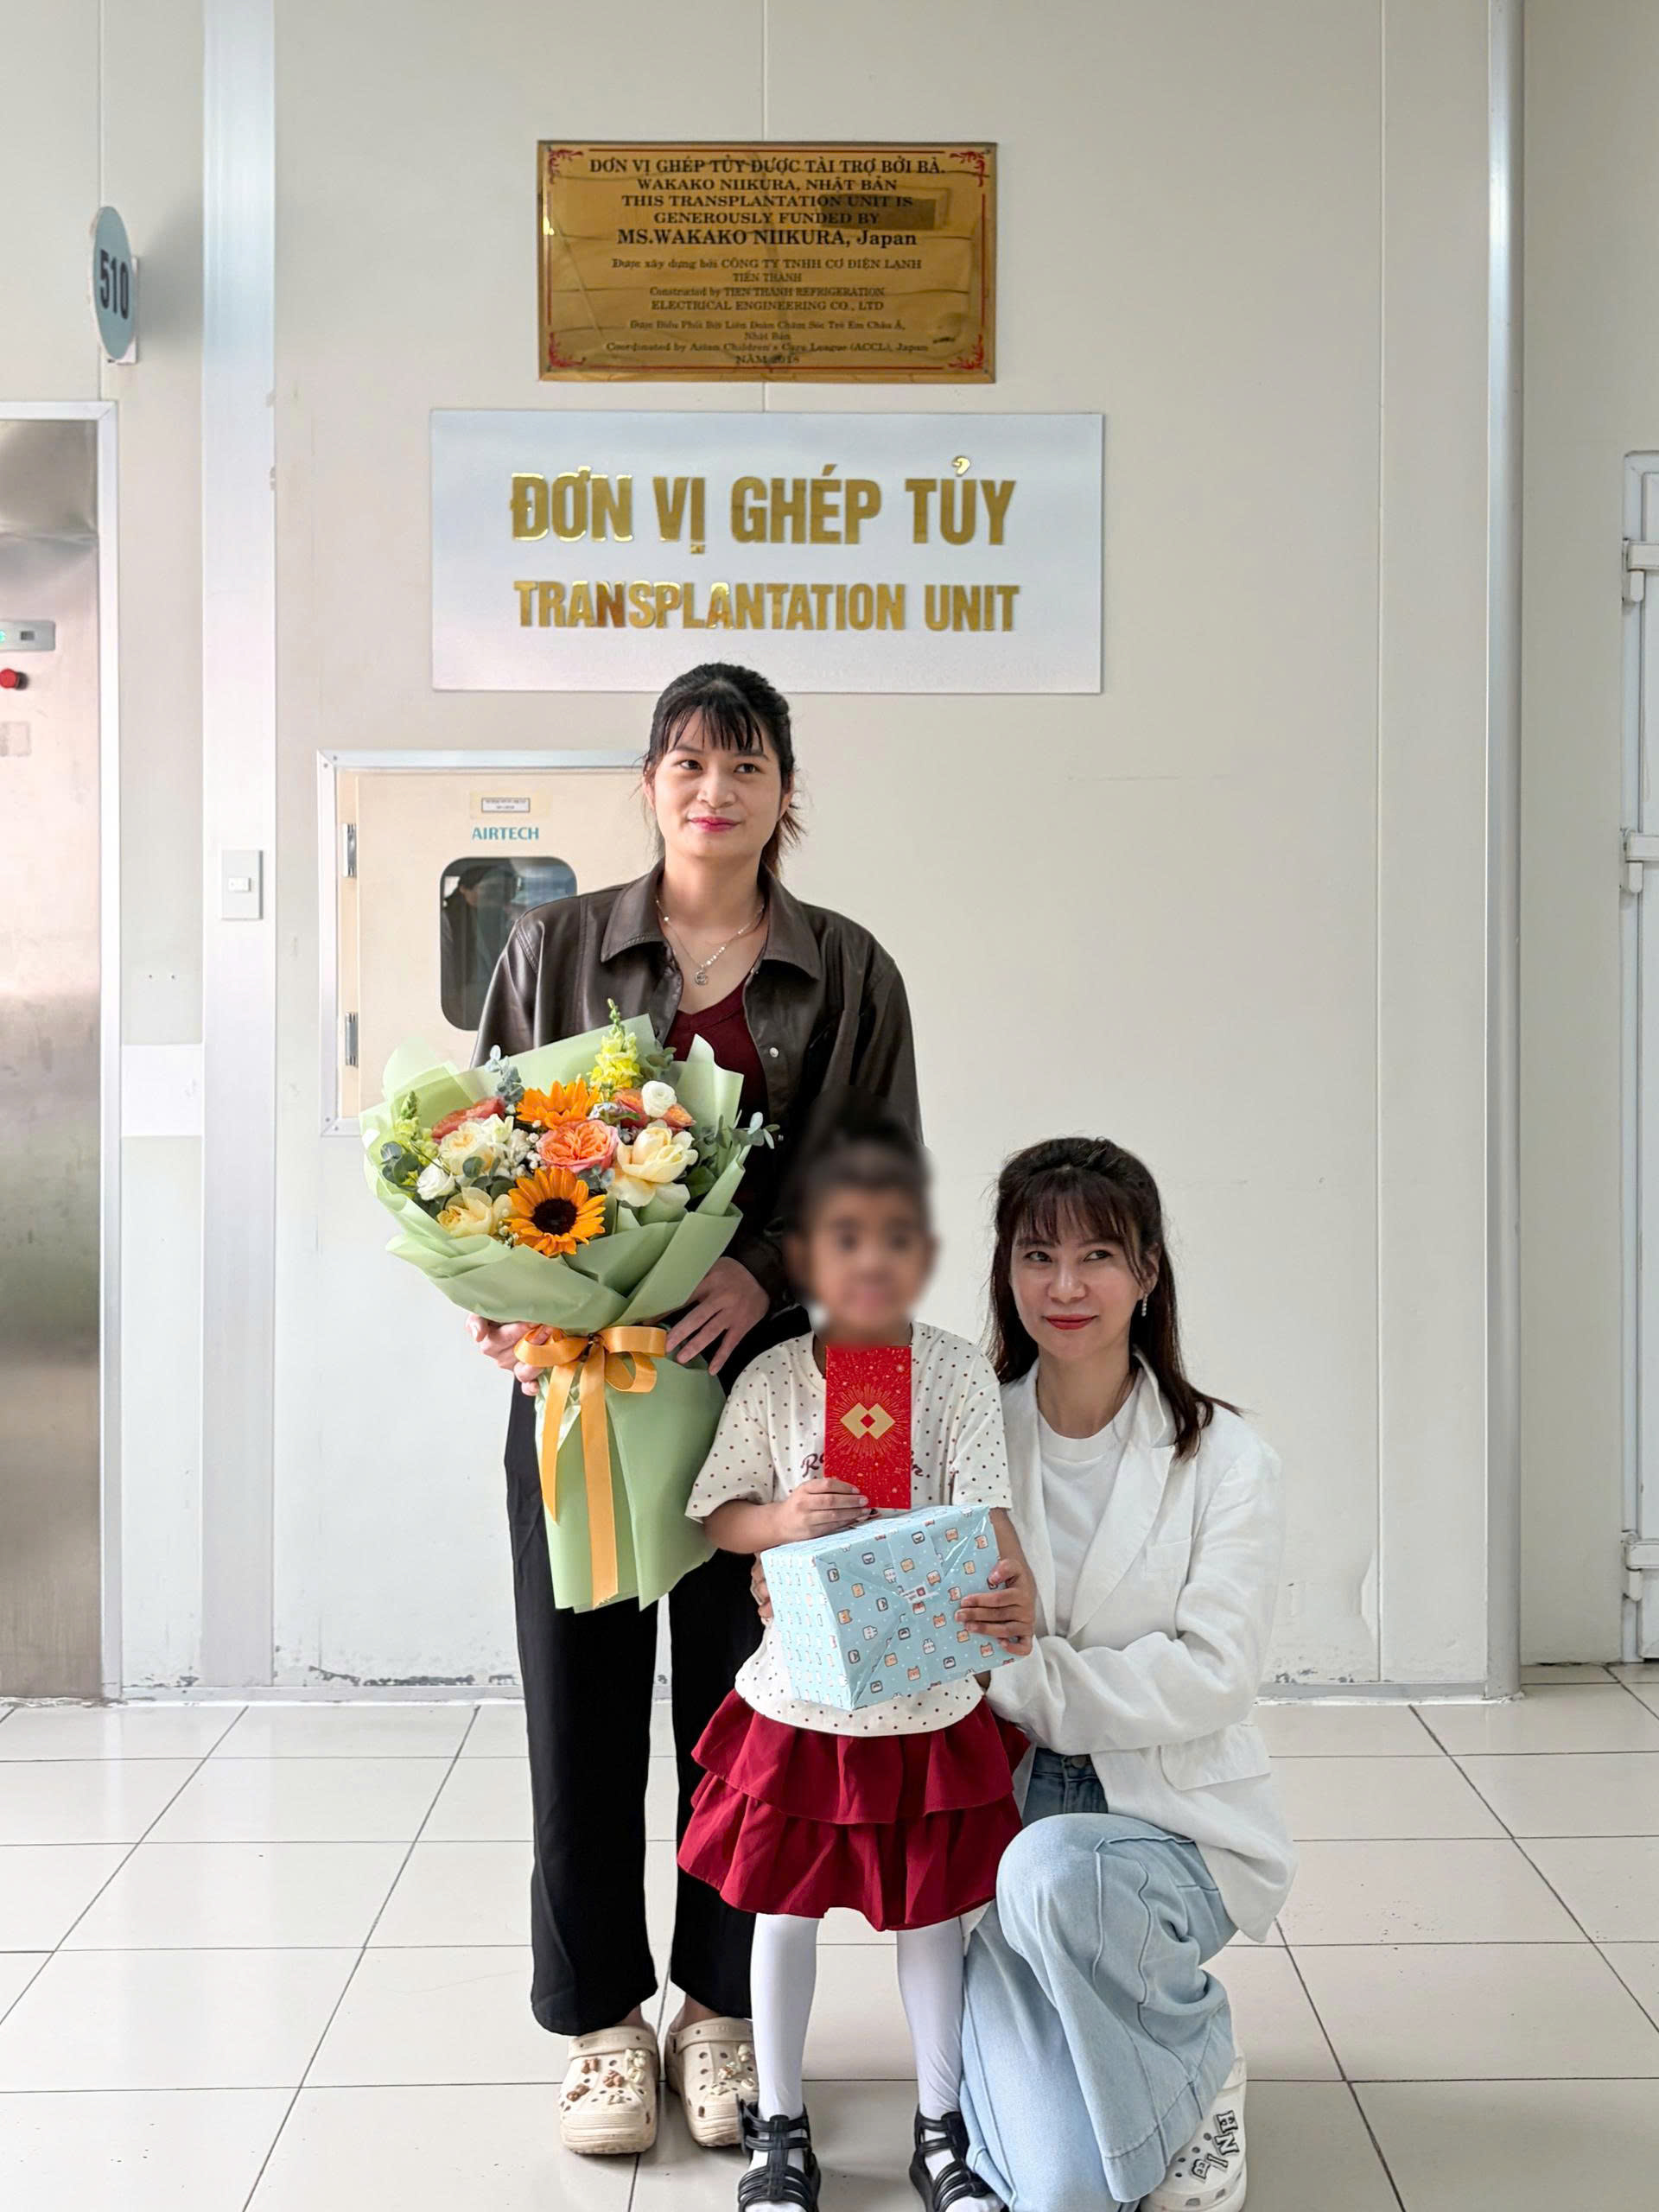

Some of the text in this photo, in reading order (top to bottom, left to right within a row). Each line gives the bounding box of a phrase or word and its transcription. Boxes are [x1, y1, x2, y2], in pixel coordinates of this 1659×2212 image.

[590, 156, 627, 173] ĐƠN
[632, 159, 650, 176] VỊ
[656, 156, 704, 173] GHÉP
[710, 155, 747, 173] TỦY
[750, 156, 800, 175] ĐƯỢC
[804, 156, 834, 173] TÀI
[840, 157, 876, 175] TRỢ
[881, 156, 912, 173] BỞI
[638, 175, 898, 192] WAKAKO NIIKURA, NHẬT BẢN
[621, 195, 913, 207] THIS TRANSPLANTATION UNIT IS
[653, 212, 880, 225] GENEROUSLY FUNDED BY
[617, 229, 917, 249] MS.WAKAKO NIIKURA, Japan
[721, 257, 759, 269] CÔNG
[762, 258, 780, 269] TY
[782, 258, 822, 269] TNHH
[99, 249, 129, 320] 510
[651, 300, 732, 311] ELECTRICAL
[735, 300, 827, 311] ENGINEERING
[858, 301, 884, 311] LTD
[510, 454, 1018, 555] ĐƠN VỊ GHÉP TỦY
[513, 580, 1020, 632] TRANSPLANTATION UNIT
[472, 827, 539, 840] AIRTECH
